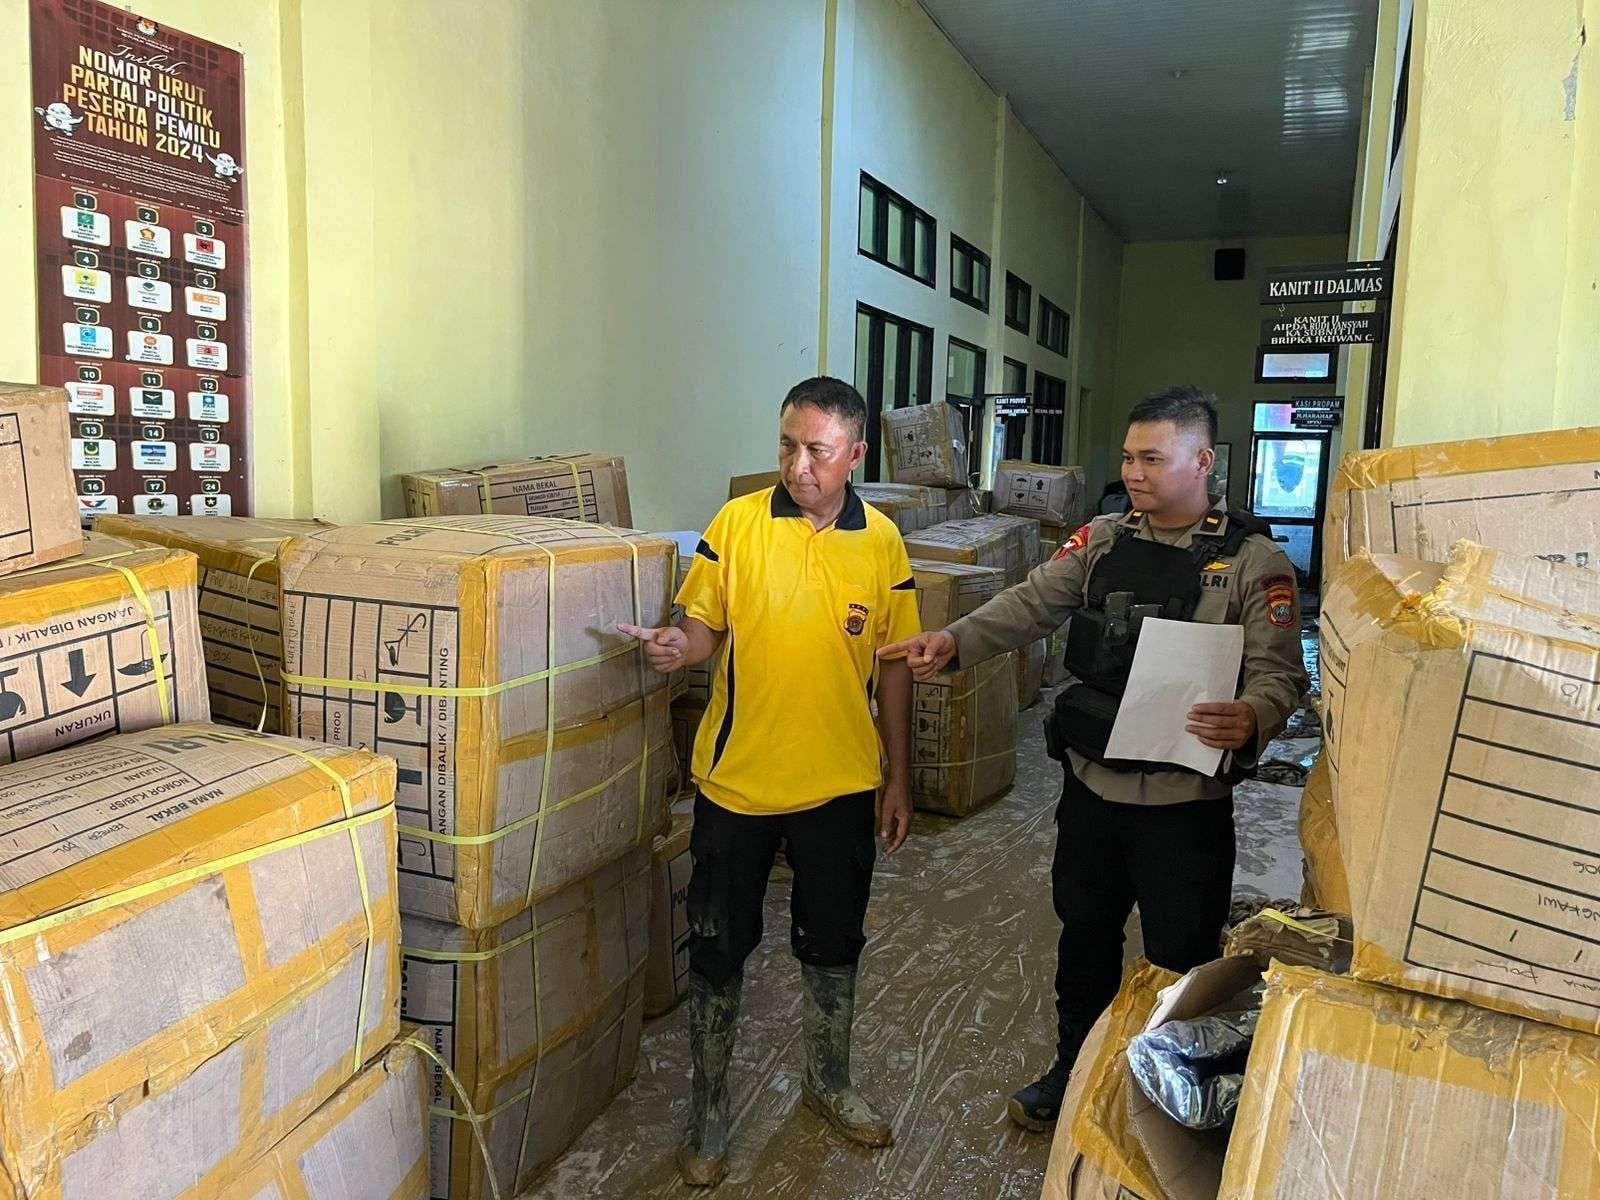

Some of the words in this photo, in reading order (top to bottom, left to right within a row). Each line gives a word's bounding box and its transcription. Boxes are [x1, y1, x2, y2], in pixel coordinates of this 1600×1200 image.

[109, 44, 187, 76] Inilah
[79, 45, 151, 87] NOMOR
[158, 73, 206, 105] URUT
[71, 63, 138, 105] PARTAI
[144, 89, 213, 128] POLITIK
[63, 83, 148, 128] PESERTA
[155, 112, 221, 149] PEMILU
[84, 112, 148, 148] TAHUN
[155, 133, 203, 163] 2024
[82, 198, 88, 206] 1
[144, 212, 151, 220] 2
[145, 267, 152, 275] 5
[1269, 281, 1311, 297] KANIT
[1314, 280, 1324, 295] II
[1327, 277, 1383, 294] DALMAS
[85, 312, 91, 320] 7
[1294, 315, 1329, 324] KANIT
[1273, 323, 1307, 331] AIPDA
[1286, 329, 1301, 337] KA
[1271, 336, 1312, 345] BRIPKA
[1315, 334, 1362, 343] IKHWAN
[84, 371, 96, 379] 10
[1295, 400, 1310, 408] KASI
[1312, 400, 1340, 408] PROPAM
[512, 485, 535, 493] NAMA
[536, 480, 558, 490] BEKAL
[1200, 574, 1229, 588] LRI
[77, 606, 134, 628] JANGAN
[16, 620, 74, 644] DIBALIK
[438, 647, 449, 721] DIBNTING
[55, 710, 112, 737] UKURAN
[333, 712, 341, 740] PROD
[437, 733, 447, 787] DIBALIK
[64, 768, 98, 783] PROD
[149, 776, 189, 797] NOMOR
[189, 788, 225, 805] NAMA
[146, 801, 188, 823] BEKAL
[437, 790, 447, 838] ANGAN
[434, 1066, 442, 1104] BEKAL
